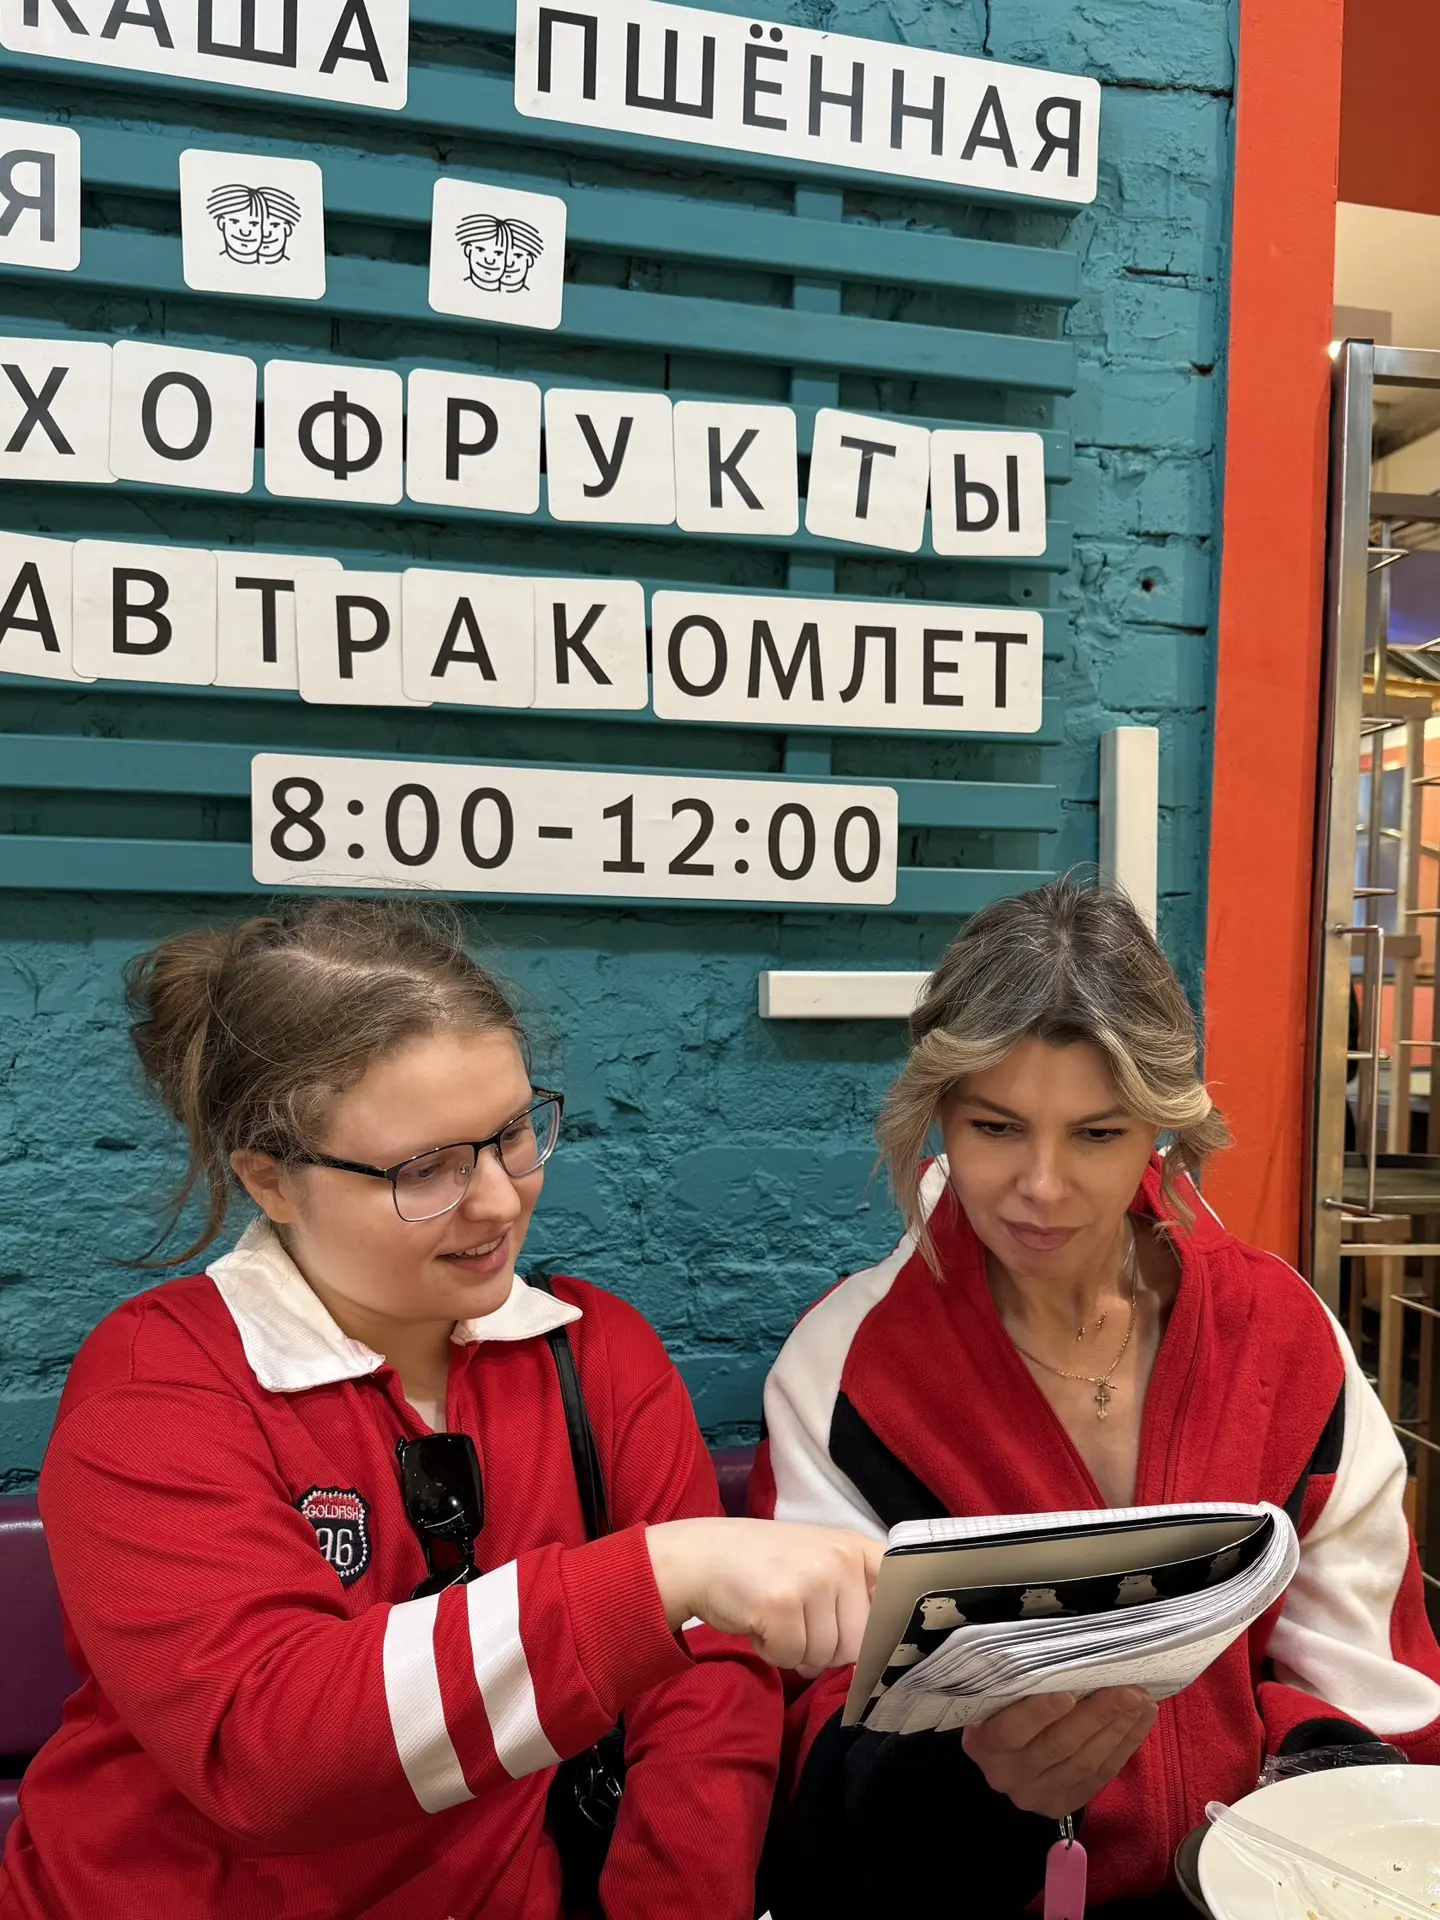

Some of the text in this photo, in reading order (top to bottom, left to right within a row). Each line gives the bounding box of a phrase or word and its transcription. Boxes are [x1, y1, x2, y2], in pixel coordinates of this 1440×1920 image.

[537, 6, 1082, 178] ПШЁННАЯ
[0, 149, 56, 243] Я
[0, 363, 1021, 534] ХОФРУКТЫ
[0, 561, 1028, 709] АВТРАК ОМЛЕТ
[306, 1504, 360, 1520] GOLDFISH
